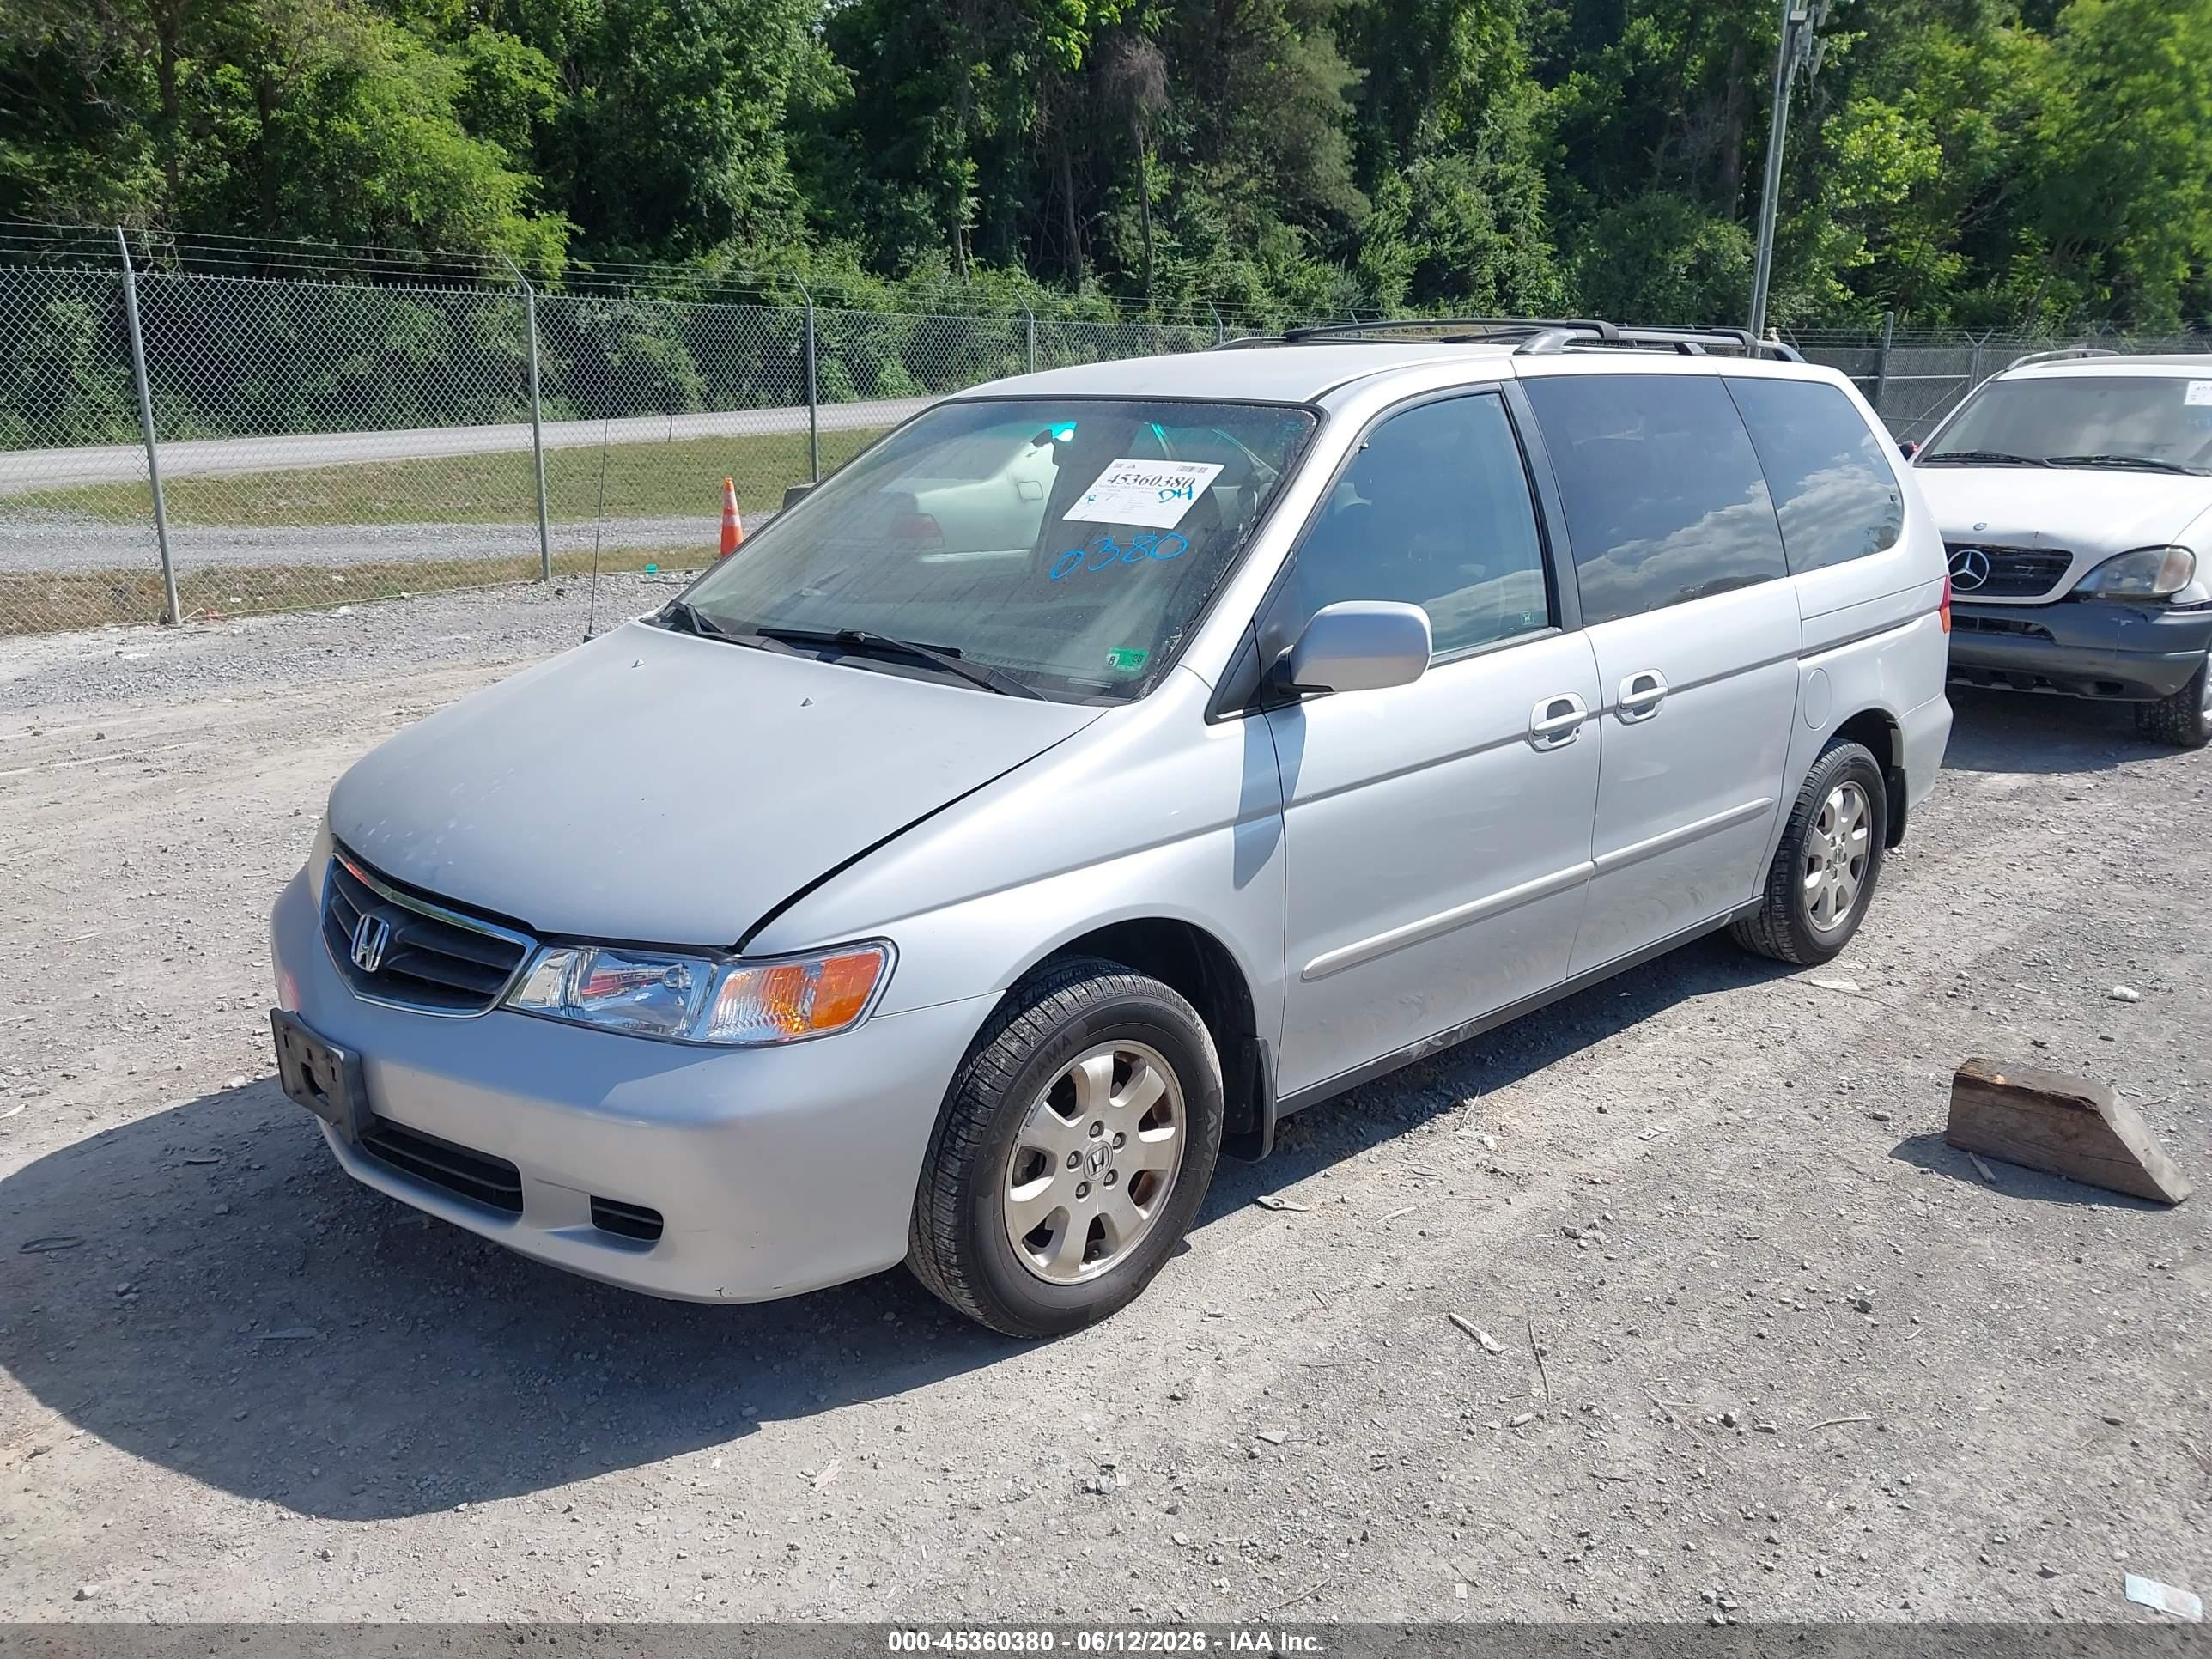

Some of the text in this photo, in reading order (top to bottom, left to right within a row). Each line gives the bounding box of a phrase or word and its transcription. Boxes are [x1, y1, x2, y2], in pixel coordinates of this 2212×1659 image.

[1108, 473, 1195, 489] 45360380
[1050, 533, 1189, 580] 0380
[1109, 656, 1116, 666] 8
